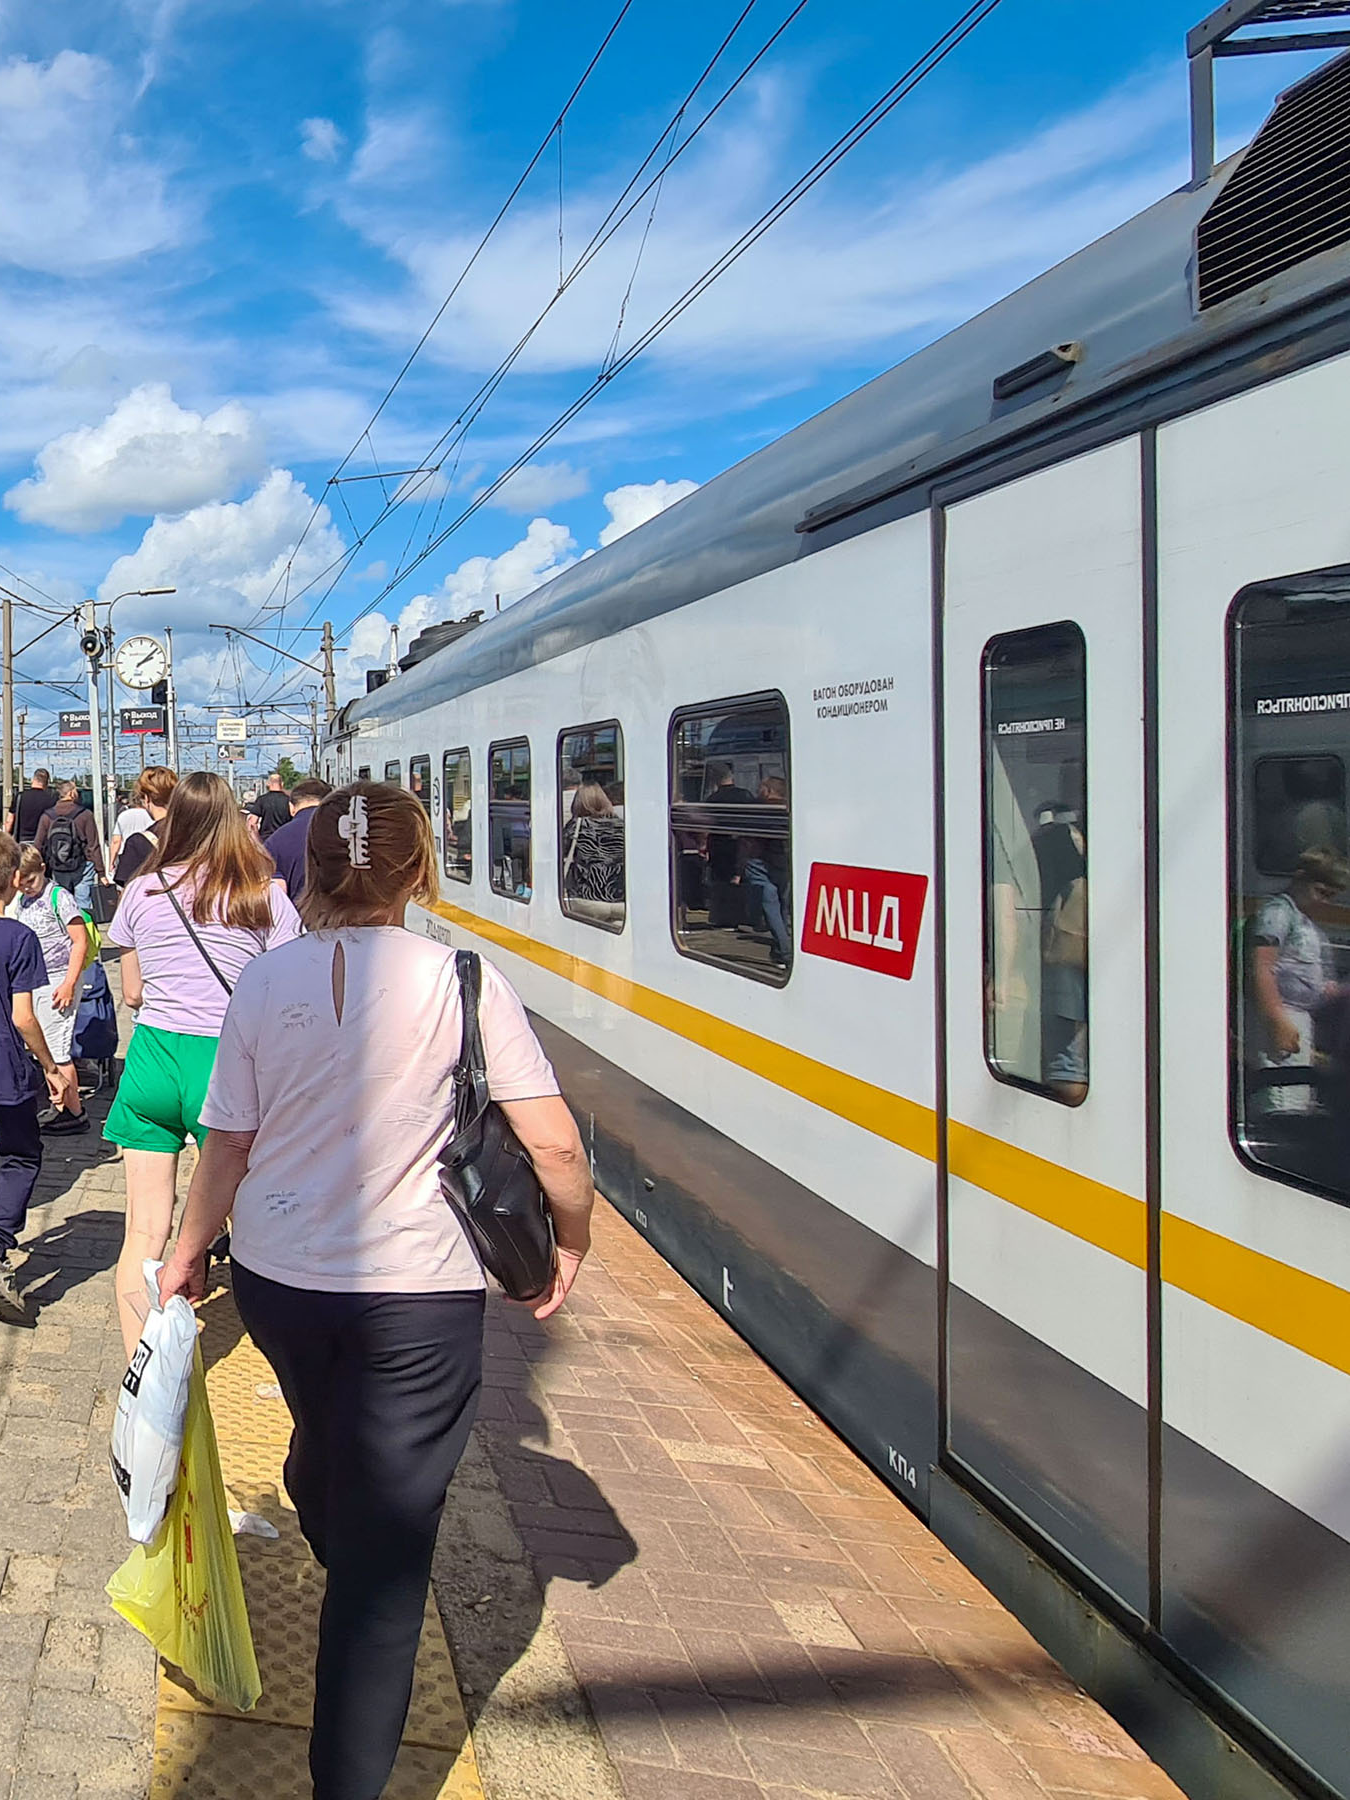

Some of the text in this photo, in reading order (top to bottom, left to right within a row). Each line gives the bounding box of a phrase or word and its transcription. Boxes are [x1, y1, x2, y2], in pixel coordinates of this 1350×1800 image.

[813, 677, 894, 701] ВАГОН ОБОРУДОВАН
[69, 713, 90, 721] Выхо
[131, 711, 158, 719] Выход
[817, 698, 888, 719] КОНДИЦИОНЕРОМ
[814, 884, 904, 953] МЦД
[889, 1445, 917, 1489] КП4
